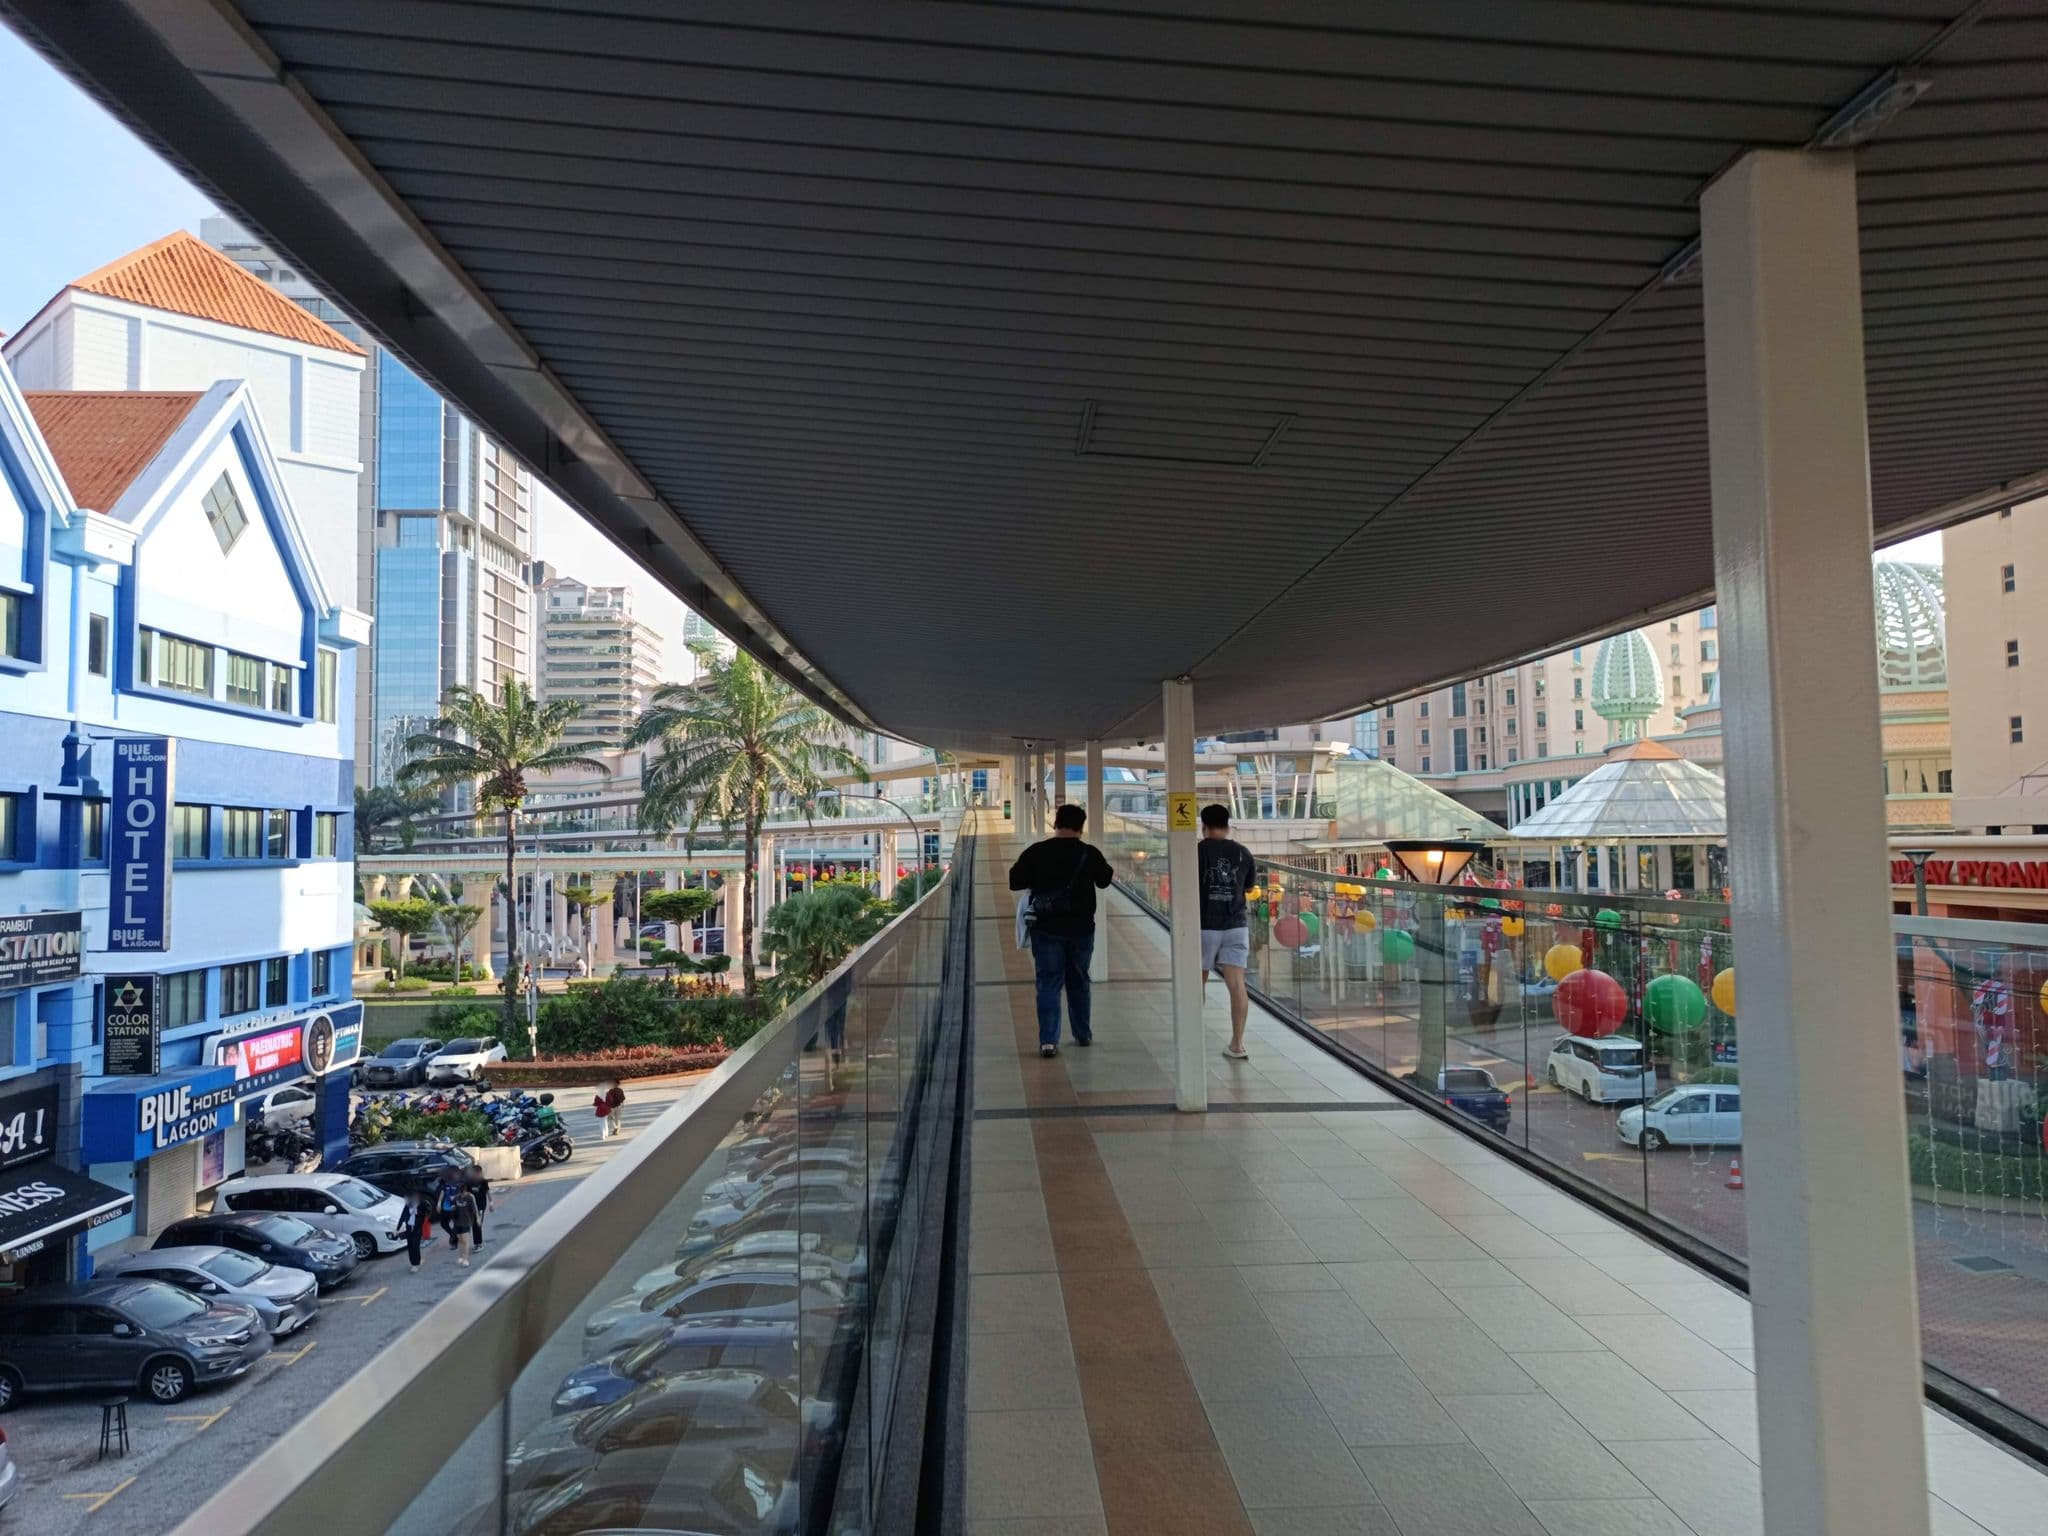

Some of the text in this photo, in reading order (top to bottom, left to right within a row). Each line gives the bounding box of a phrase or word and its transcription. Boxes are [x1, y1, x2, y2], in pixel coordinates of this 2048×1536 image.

[119, 744, 151, 756] BLUE
[124, 767, 156, 924] HOTEL
[112, 929, 145, 941] BLUE
[0, 931, 81, 961] STATION
[107, 1014, 149, 1026] COLOR
[107, 1026, 149, 1036] STATION
[141, 1085, 235, 1132] BLUE HOTEL
[156, 1111, 218, 1148] LAGOON
